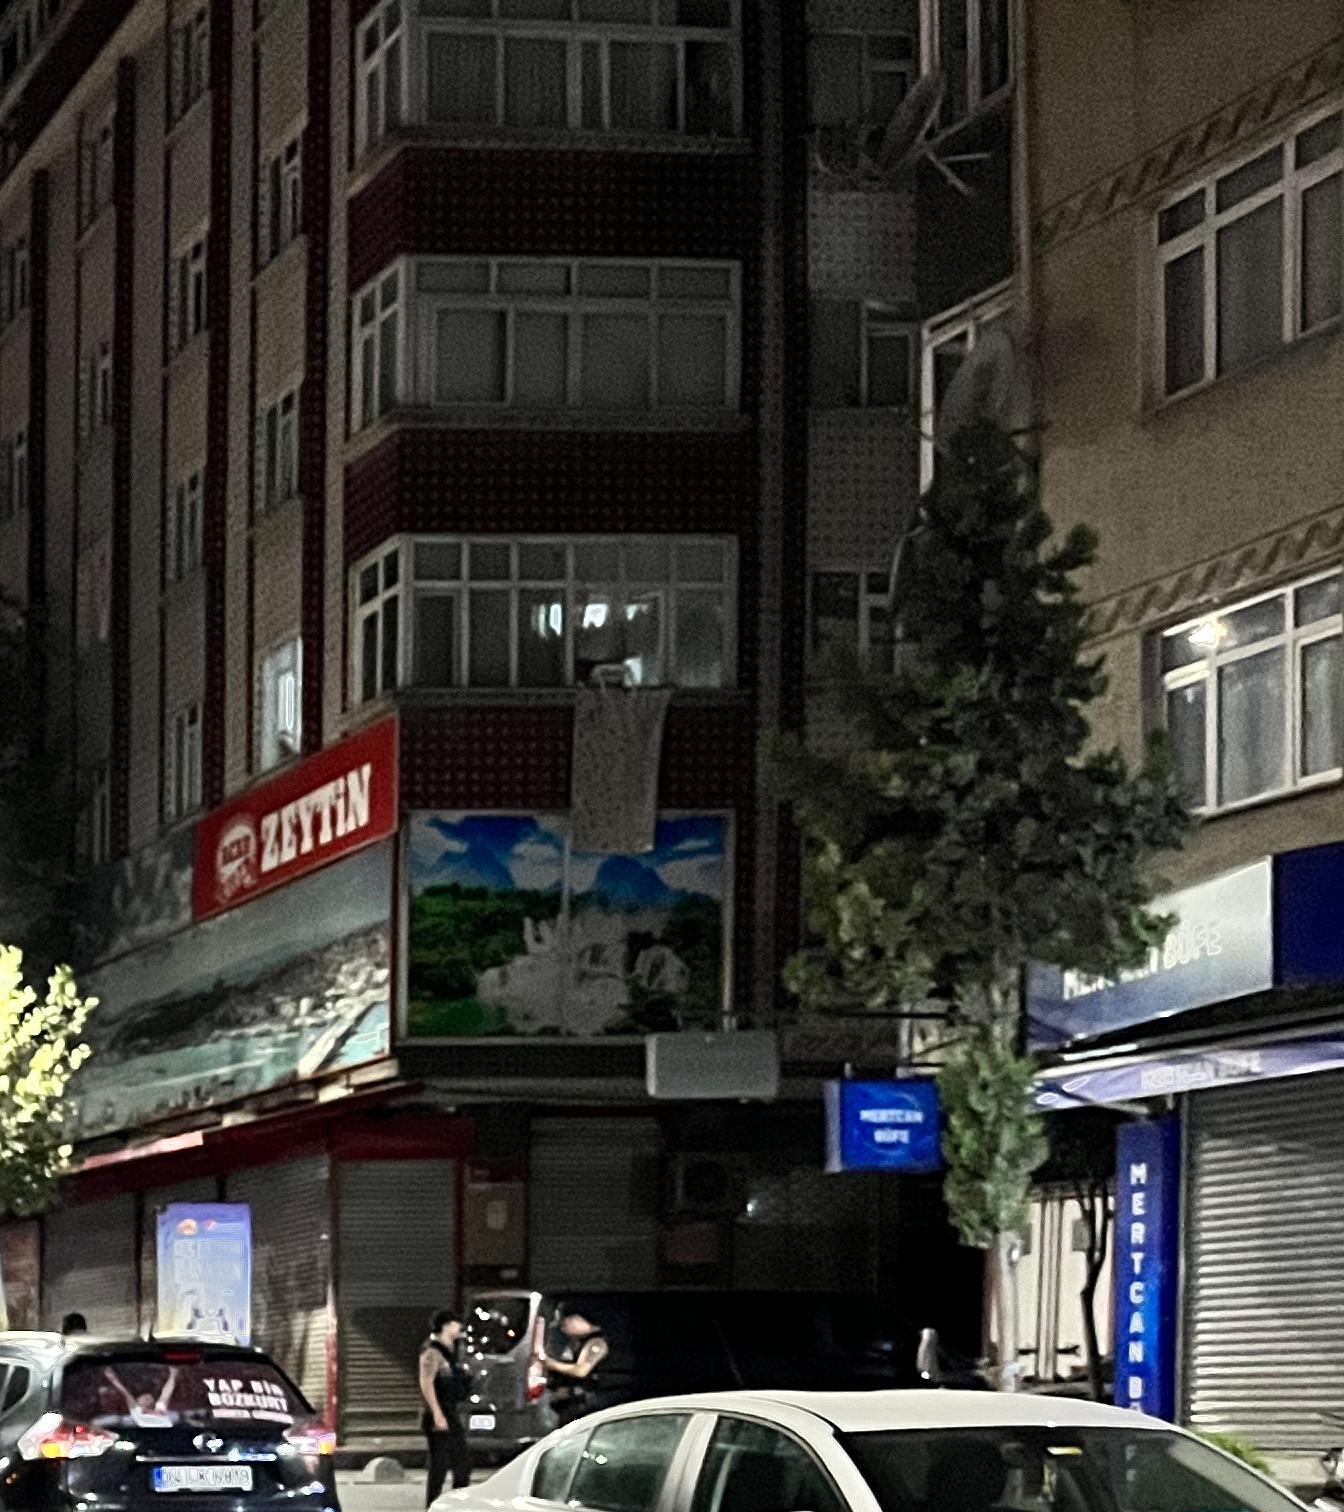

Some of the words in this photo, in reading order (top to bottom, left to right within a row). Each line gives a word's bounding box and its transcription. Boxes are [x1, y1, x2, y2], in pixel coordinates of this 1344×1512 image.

[1128, 1163, 1148, 1363] MERTCAN
[203, 1379, 243, 1392] YAP
[208, 1392, 288, 1412] BOZKURT
